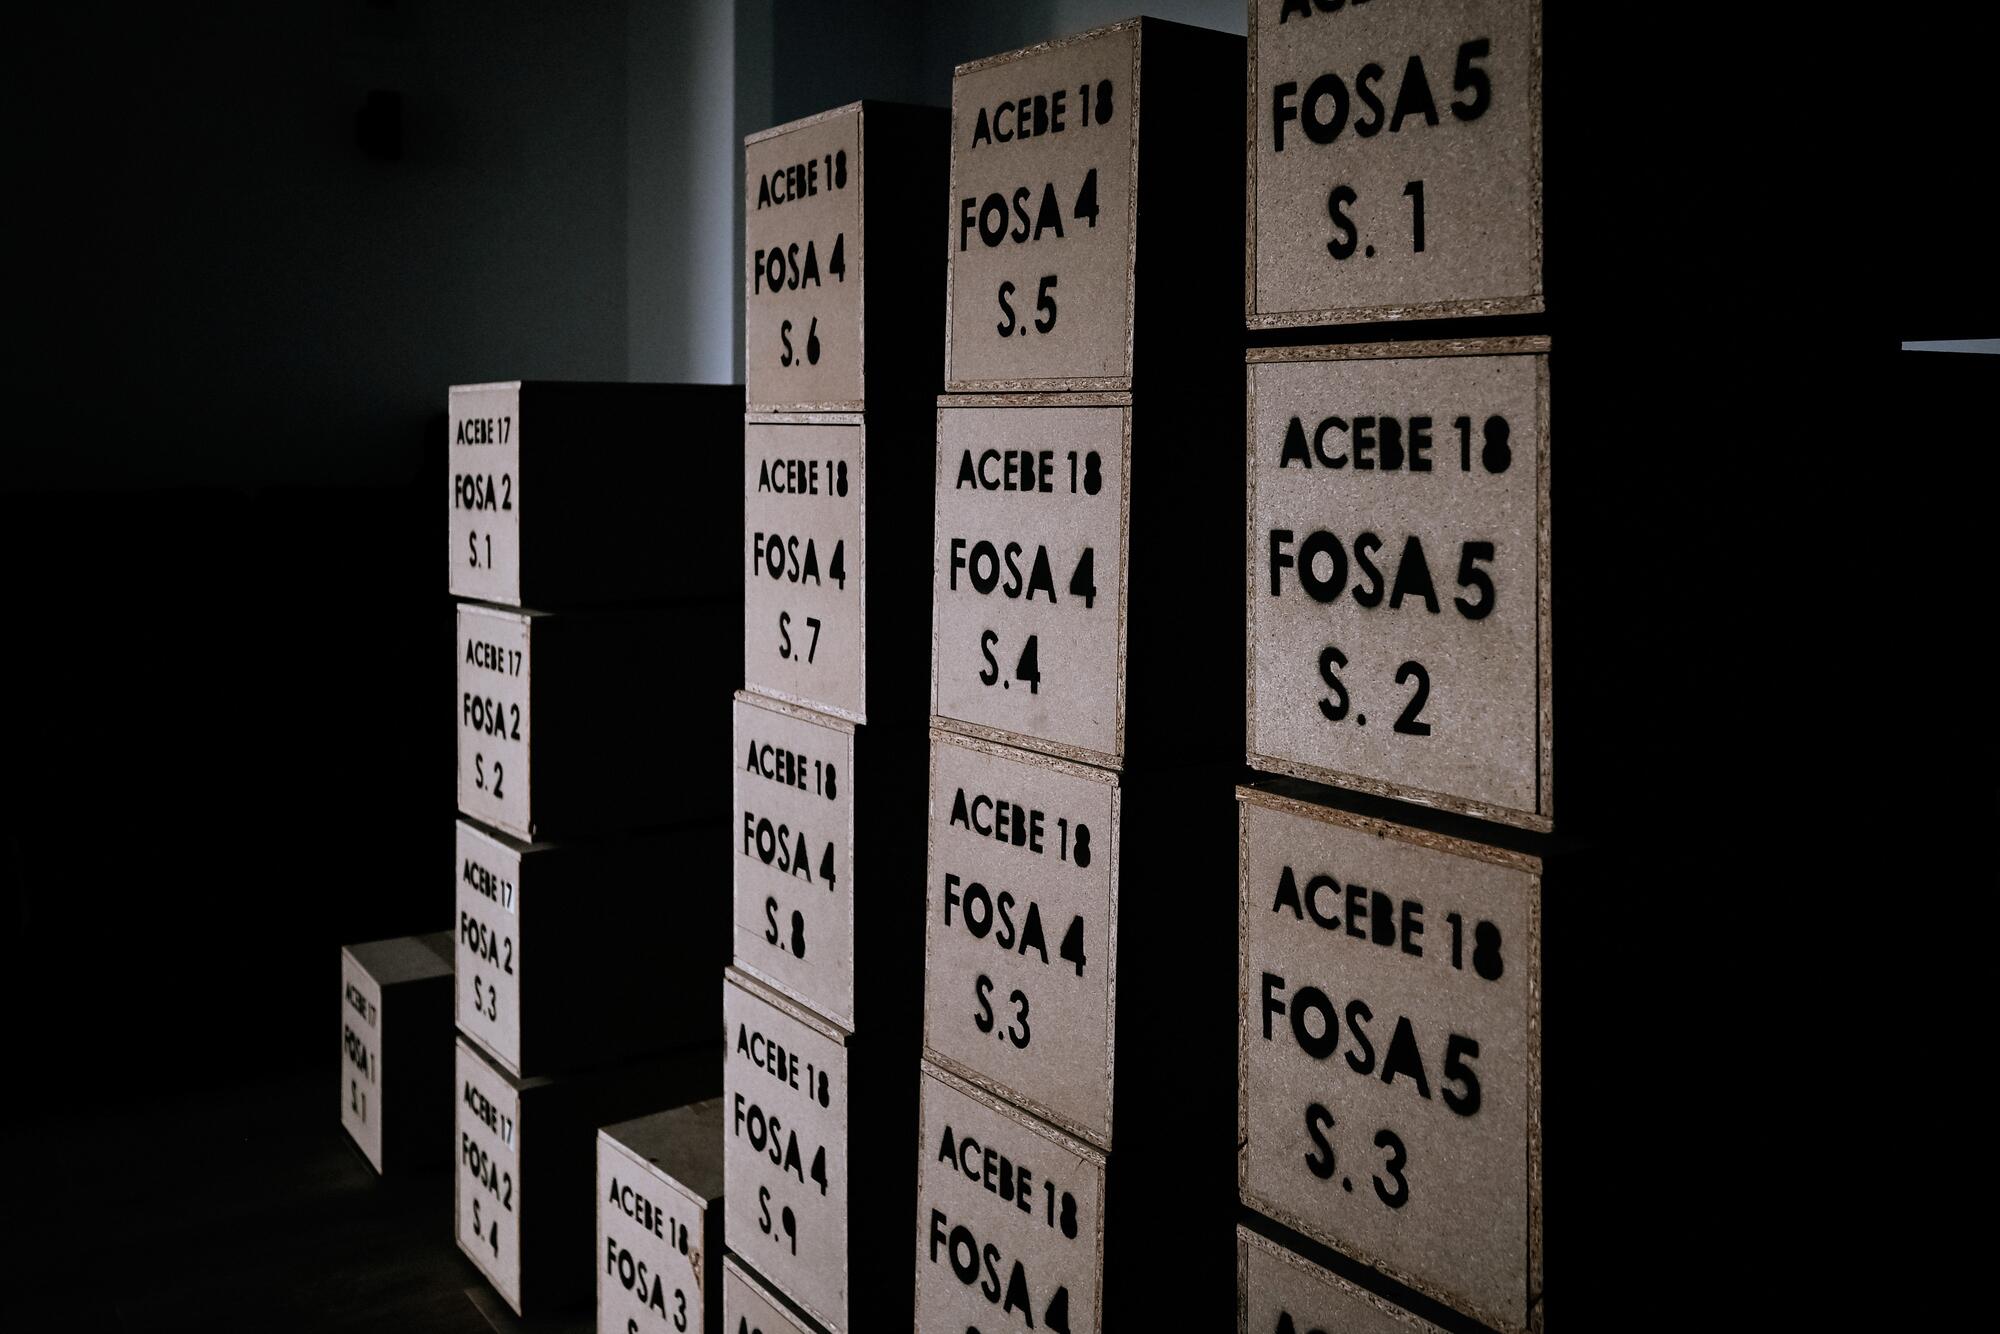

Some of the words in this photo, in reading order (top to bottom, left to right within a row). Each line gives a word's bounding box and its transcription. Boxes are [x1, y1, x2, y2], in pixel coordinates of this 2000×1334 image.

[972, 90, 1066, 149] ACEBE
[1079, 79, 1113, 127] 18
[1272, 54, 1439, 152] FOSA
[1451, 37, 1492, 122] 5
[758, 159, 817, 210] ACEBE
[825, 150, 847, 191] 18
[961, 183, 1064, 251] FOSA
[1074, 168, 1099, 228] 4
[755, 241, 821, 295] FOSA
[830, 233, 845, 282] 4
[457, 419, 493, 445] ACEBE
[498, 417, 510, 444] 17
[1280, 415, 1432, 474] ACEBE
[1454, 414, 1512, 474] 18
[455, 474, 496, 512] FOSA
[502, 473, 511, 510] 2
[759, 459, 818, 495] ACEBE
[826, 460, 848, 497] 18
[956, 449, 1053, 493] ACEBE
[1067, 451, 1102, 495] 18
[754, 532, 820, 586] FOSA
[830, 540, 845, 590] 4
[951, 538, 1057, 604] FOSA
[1070, 547, 1096, 609] 4
[1270, 529, 1441, 615] FOSA
[1454, 541, 1496, 622] 5
[466, 640, 503, 673] ACEBE
[509, 650, 521, 676] 17
[464, 693, 506, 739] FOSA
[511, 703, 520, 741] 2
[747, 740, 807, 790] ACEBE
[815, 760, 836, 800] 18
[744, 811, 811, 883] FOSA
[820, 842, 836, 892] 4
[950, 788, 1044, 854] ACEBE
[1057, 818, 1091, 868] 18
[464, 859, 497, 902] ACEBE
[501, 880, 512, 907] 17
[461, 911, 499, 968] FOSA
[504, 937, 512, 975] 2
[945, 873, 1049, 965] FOSA
[1060, 915, 1086, 977] 4
[1272, 866, 1424, 957] ACEBE
[1446, 912, 1504, 981] 18
[737, 1024, 799, 1090] ACEBE
[807, 1064, 829, 1108] 18
[1262, 972, 1432, 1100] FOSA
[1441, 1034, 1481, 1118] 5
[463, 1082, 497, 1135] ACEBE
[501, 1114, 512, 1143] 17
[735, 1093, 804, 1183] FOSA
[811, 1146, 828, 1196] 4
[462, 1132, 499, 1206] FOSA
[503, 1172, 512, 1211] 2
[938, 1126, 1031, 1214] ACEBE
[1044, 1180, 1078, 1239] 18
[608, 1178, 663, 1240] ACEBE
[670, 1217, 689, 1255] 18
[608, 1235, 666, 1322] FOSA
[674, 1289, 686, 1333] 3
[930, 1208, 1034, 1329] FOSA
[1044, 1286, 1071, 1334] 4
